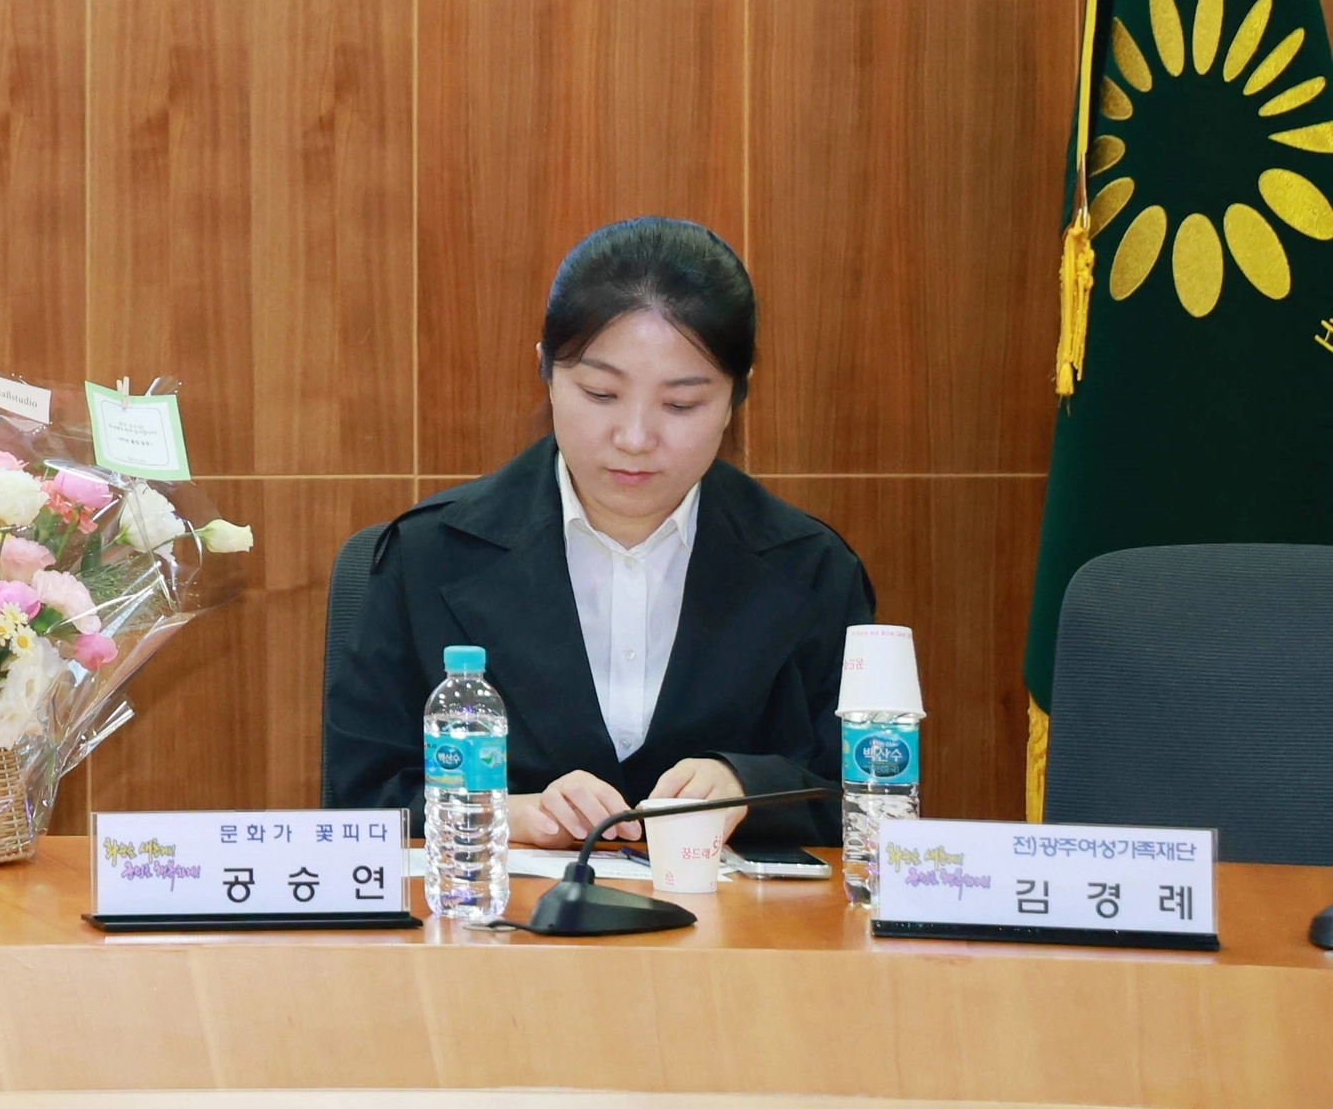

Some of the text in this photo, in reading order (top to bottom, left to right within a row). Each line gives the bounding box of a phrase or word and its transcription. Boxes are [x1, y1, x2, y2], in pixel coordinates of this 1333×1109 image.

[863, 747, 903, 763] 백산수
[220, 822, 388, 844] 문화가 꽃피다
[1012, 834, 1197, 863] 전)광주여성가족재단
[222, 864, 385, 903] 공승연
[1015, 879, 1194, 921] 김경례
